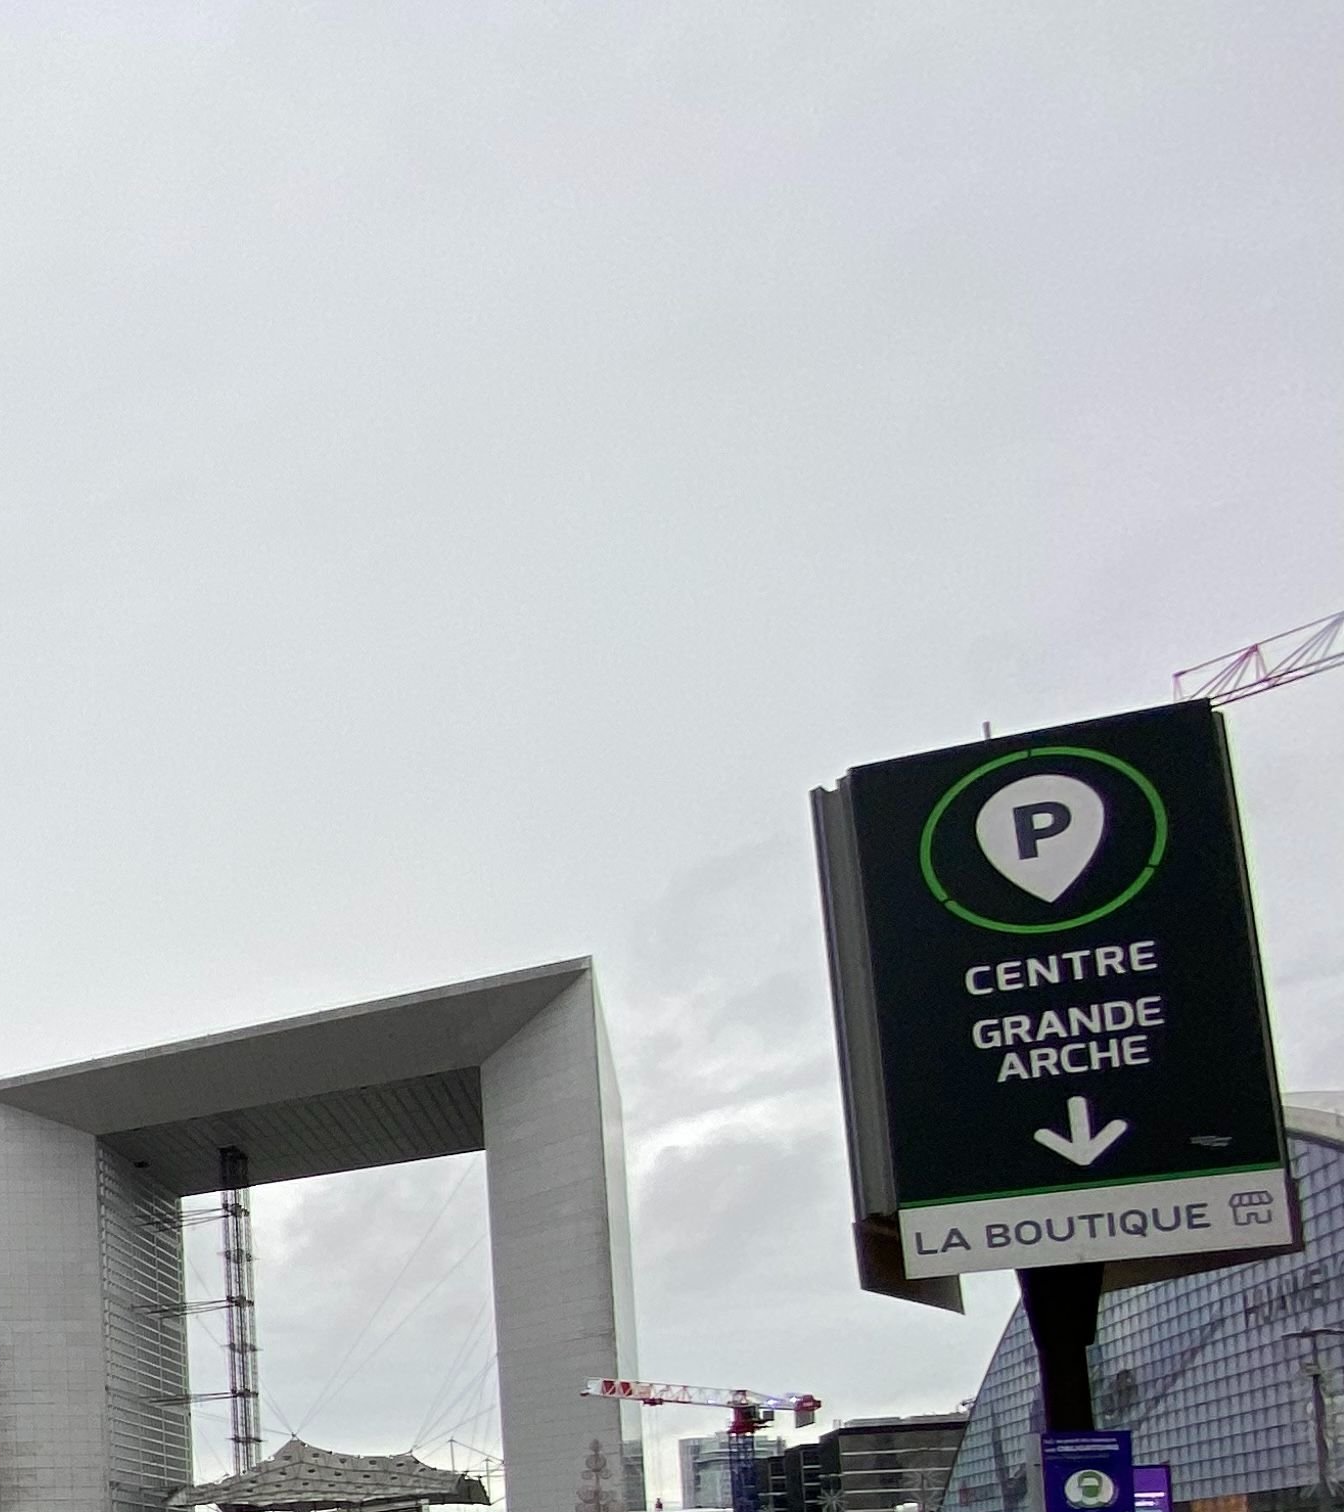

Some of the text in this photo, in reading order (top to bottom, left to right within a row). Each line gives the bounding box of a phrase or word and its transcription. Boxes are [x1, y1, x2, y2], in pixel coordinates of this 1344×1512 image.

[1014, 801, 1072, 860] P
[963, 939, 1159, 996] CENTRE
[970, 994, 1165, 1050] GRANDE
[996, 1034, 1151, 1083] ARCHE
[914, 1202, 1212, 1257] LA BOUTIQUE
